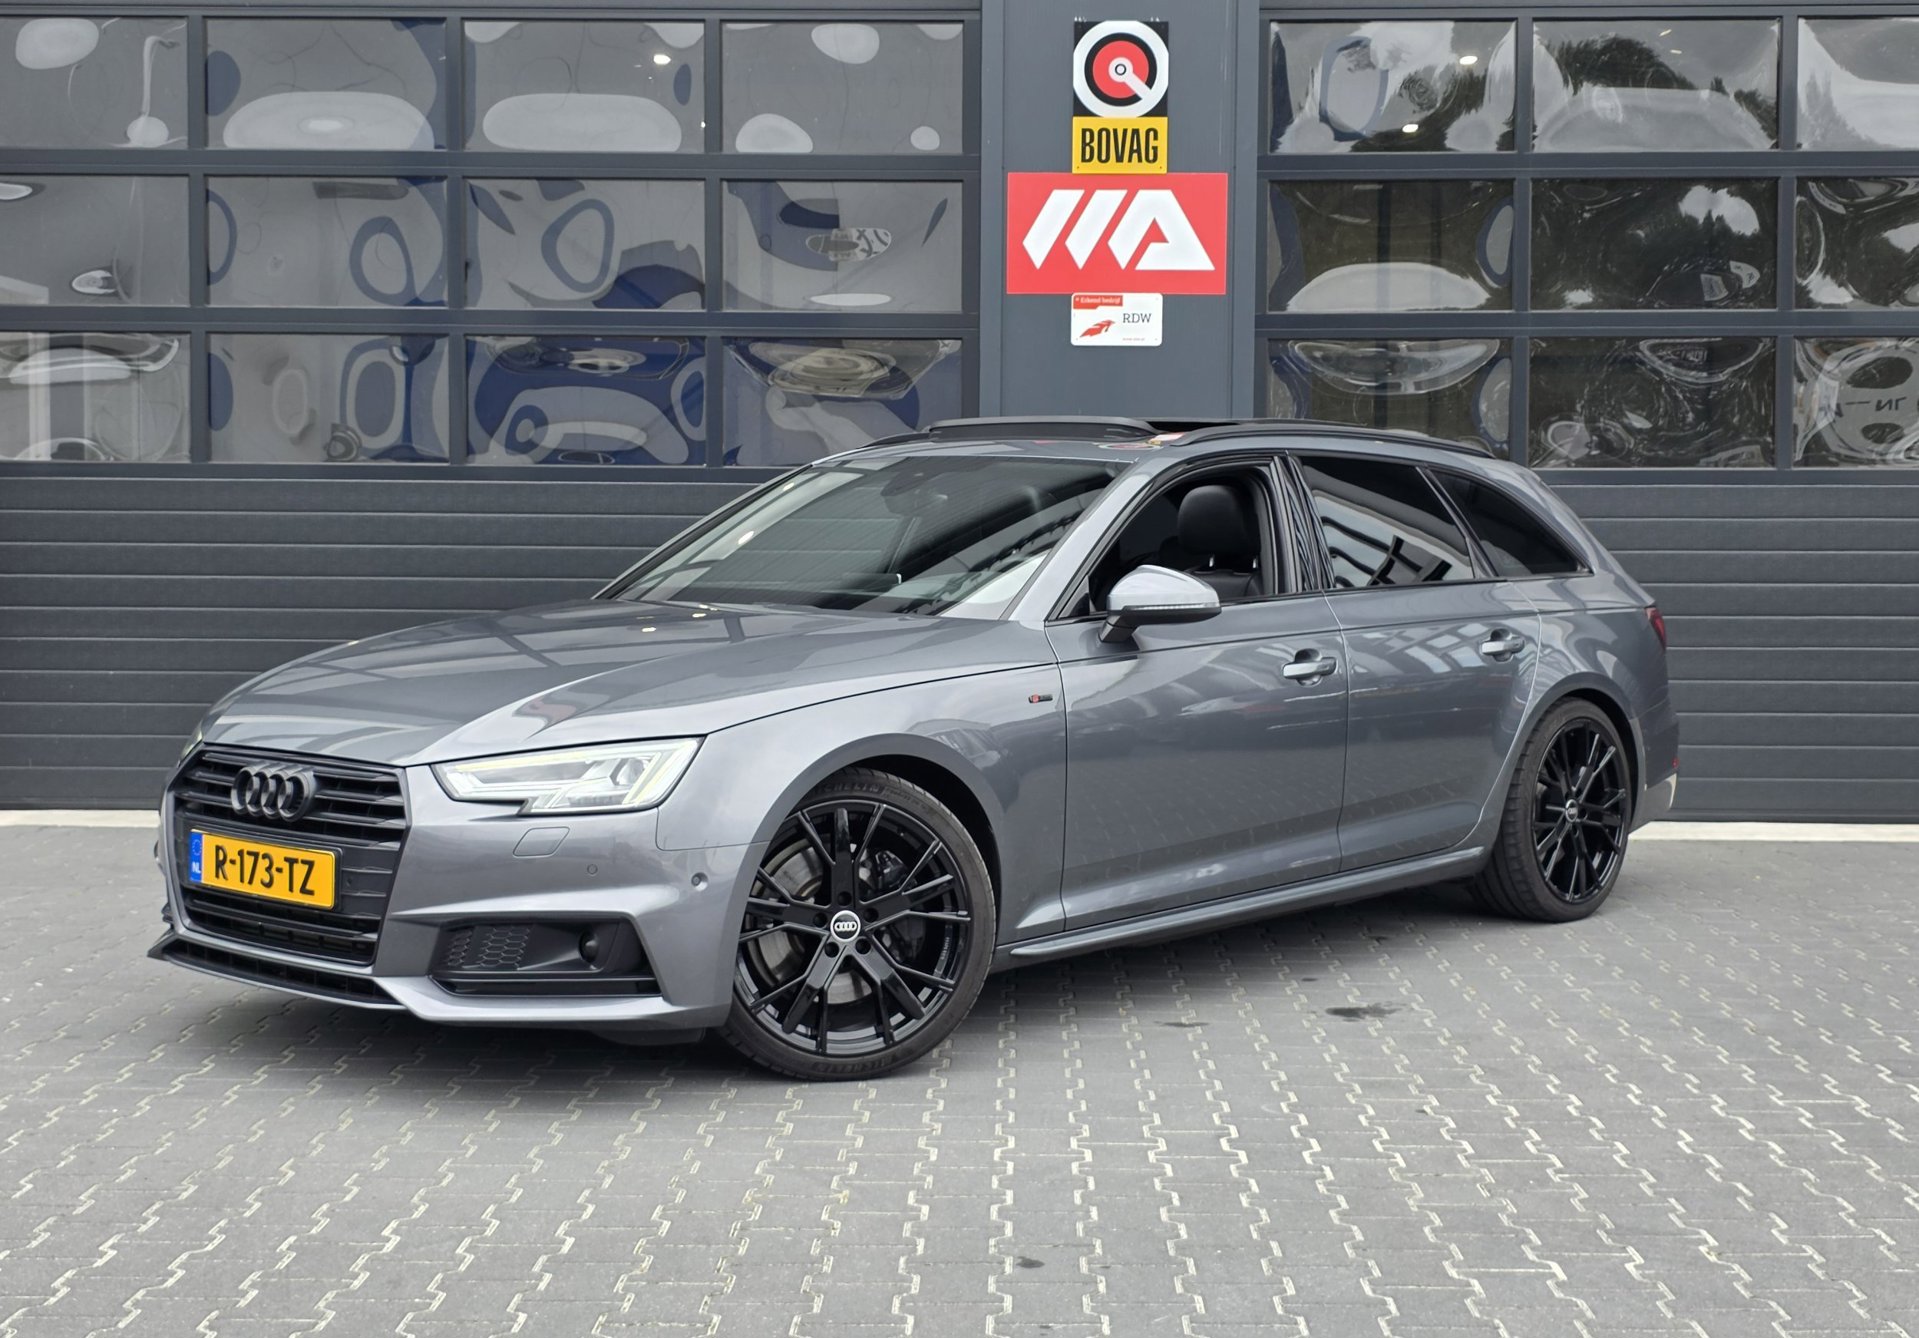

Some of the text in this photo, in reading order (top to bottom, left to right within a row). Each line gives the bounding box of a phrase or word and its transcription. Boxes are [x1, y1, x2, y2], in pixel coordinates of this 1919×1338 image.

[1081, 128, 1158, 163] BOVAG
[1122, 313, 1152, 323] RDW
[191, 861, 201, 874] NL
[215, 845, 315, 896] R-173-TZ
